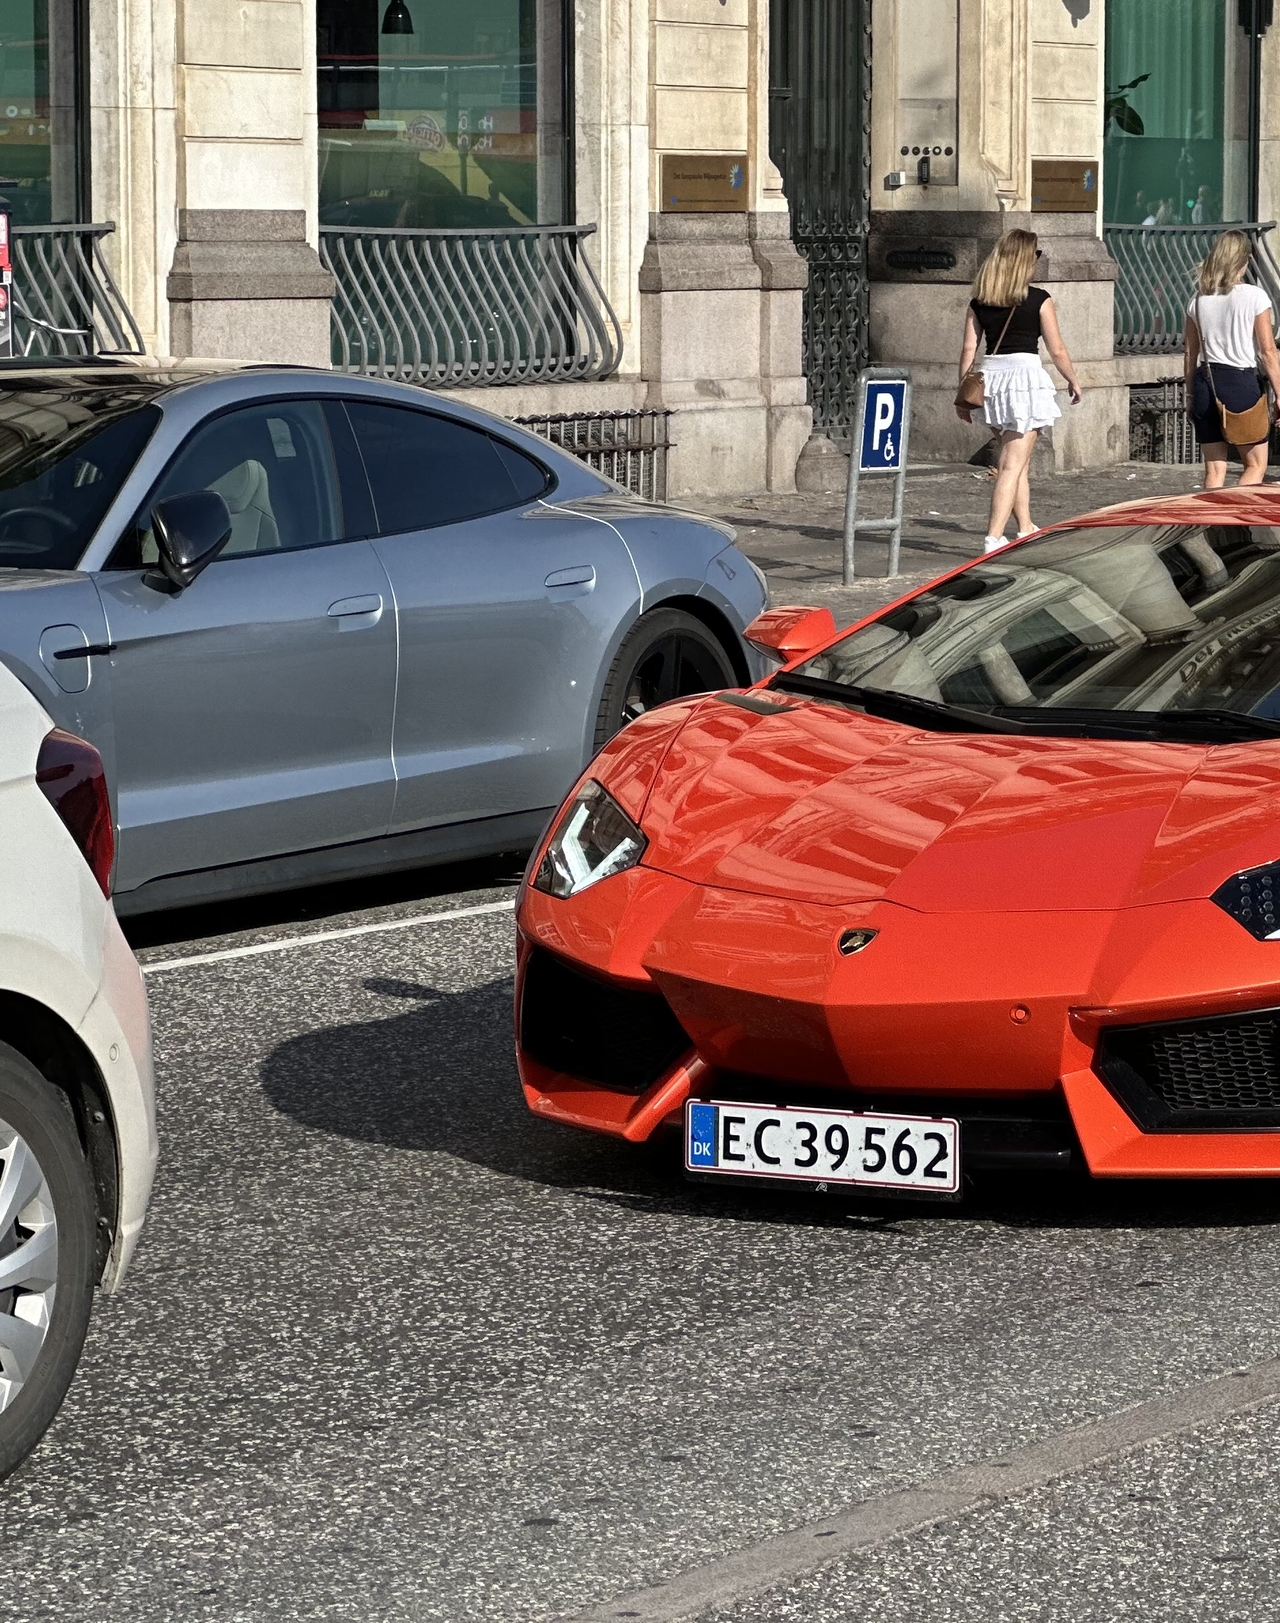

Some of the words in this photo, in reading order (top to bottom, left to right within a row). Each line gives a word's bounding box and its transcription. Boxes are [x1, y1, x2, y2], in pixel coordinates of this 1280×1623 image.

[872, 392, 895, 451] P
[693, 1141, 712, 1157] DK
[722, 1115, 781, 1166] EC
[794, 1121, 850, 1172] 39
[862, 1126, 949, 1179] 562
